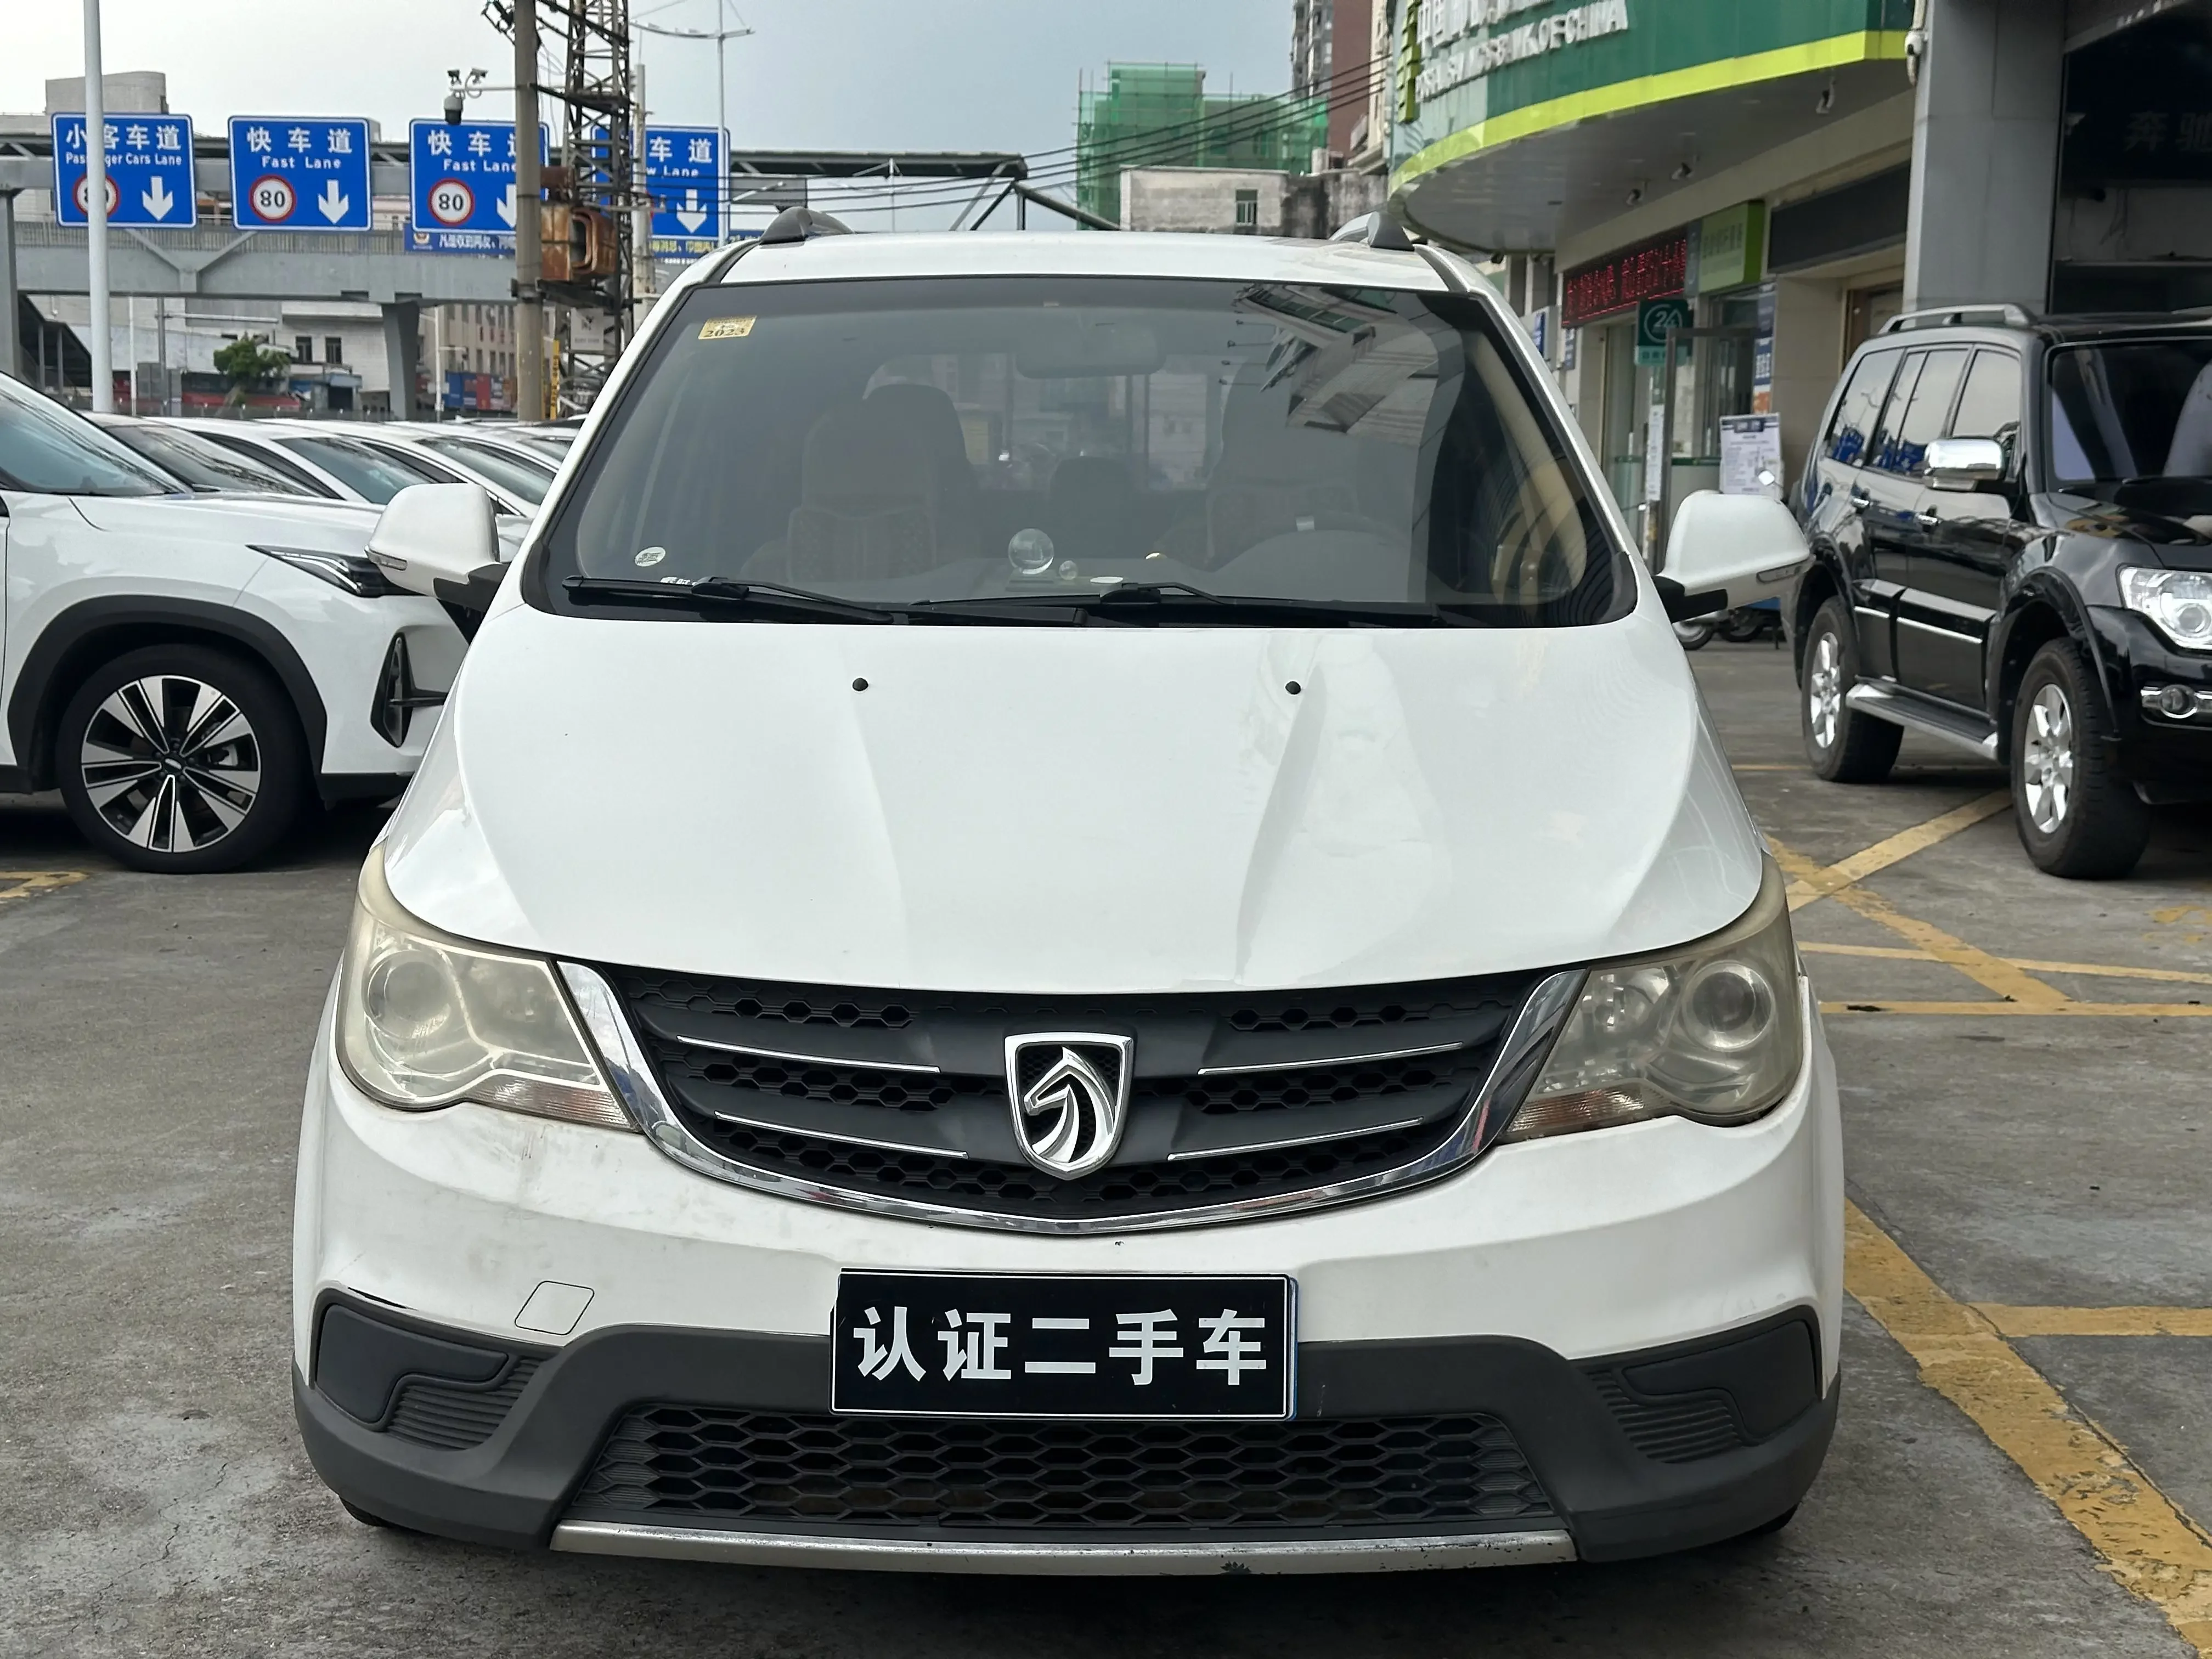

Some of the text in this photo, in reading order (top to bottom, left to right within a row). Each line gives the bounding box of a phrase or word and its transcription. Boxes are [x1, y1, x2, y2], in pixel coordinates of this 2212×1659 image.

[66, 123, 181, 150] 小客车道
[247, 126, 353, 154] 快车道
[66, 152, 182, 167] Pasger Cars Lane
[261, 156, 341, 170] Fast Lane
[443, 159, 476, 172] Fast
[663, 165, 699, 177] Lane
[260, 190, 285, 208] 80
[438, 194, 463, 211] 80
[854, 1306, 1267, 1386] 认证二手车
